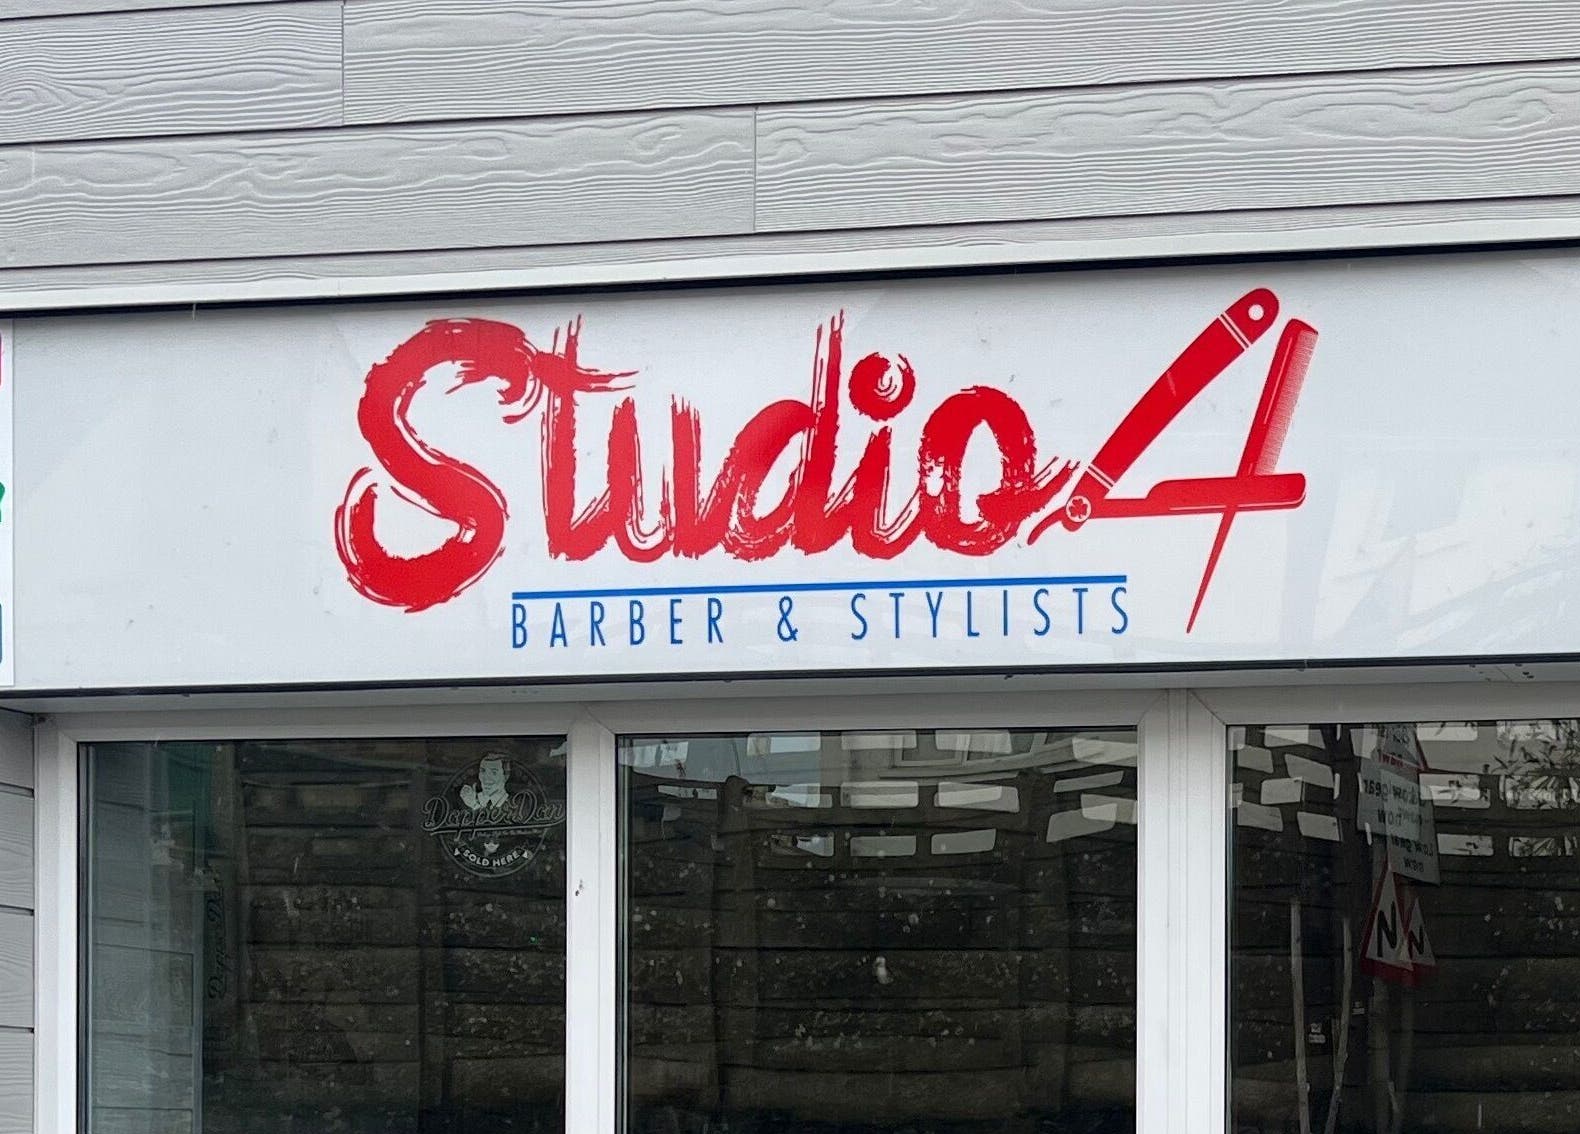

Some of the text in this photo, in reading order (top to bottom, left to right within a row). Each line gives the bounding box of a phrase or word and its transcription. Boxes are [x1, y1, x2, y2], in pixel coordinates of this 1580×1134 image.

[334, 309, 1080, 613] Studio
[511, 586, 1129, 649] BARBER & STYLISTS
[422, 789, 567, 842] Dapper Dan
[462, 849, 521, 867] SOLD HERE
